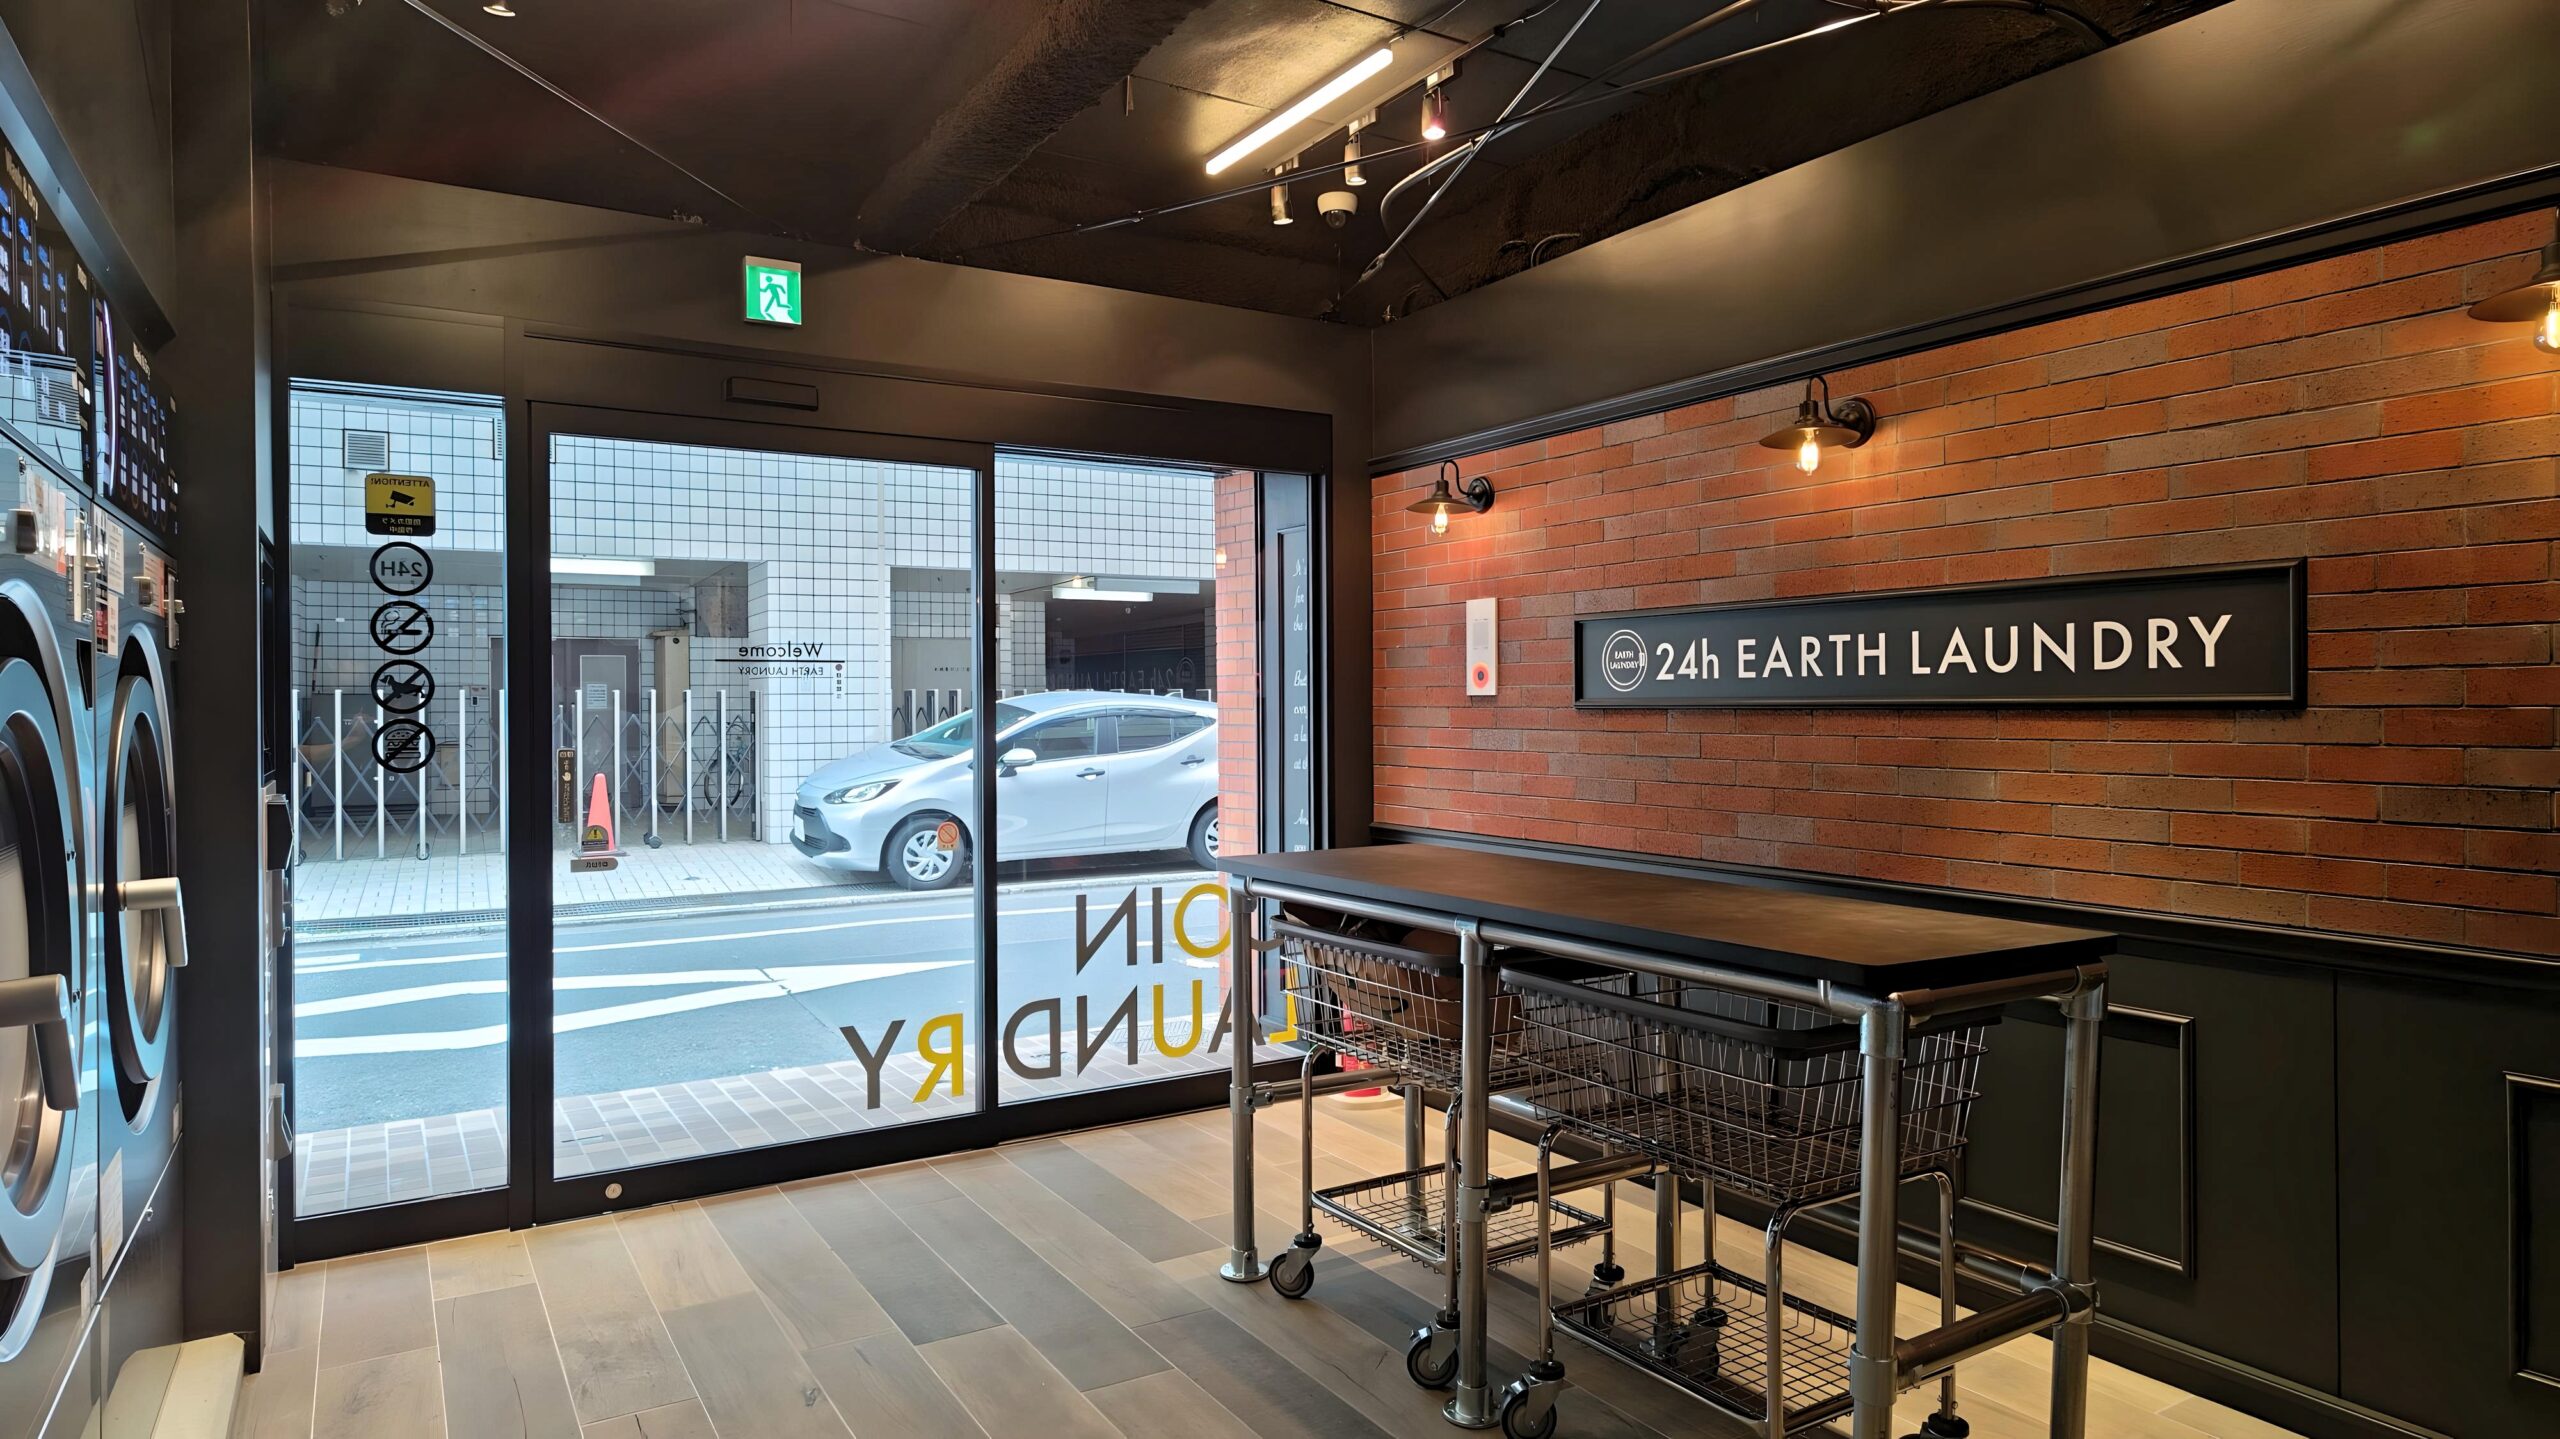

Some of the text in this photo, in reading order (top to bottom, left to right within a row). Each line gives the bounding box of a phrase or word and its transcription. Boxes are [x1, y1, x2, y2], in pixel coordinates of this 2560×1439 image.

[1656, 614, 2233, 682] 24h EARTH LAUNDRY
